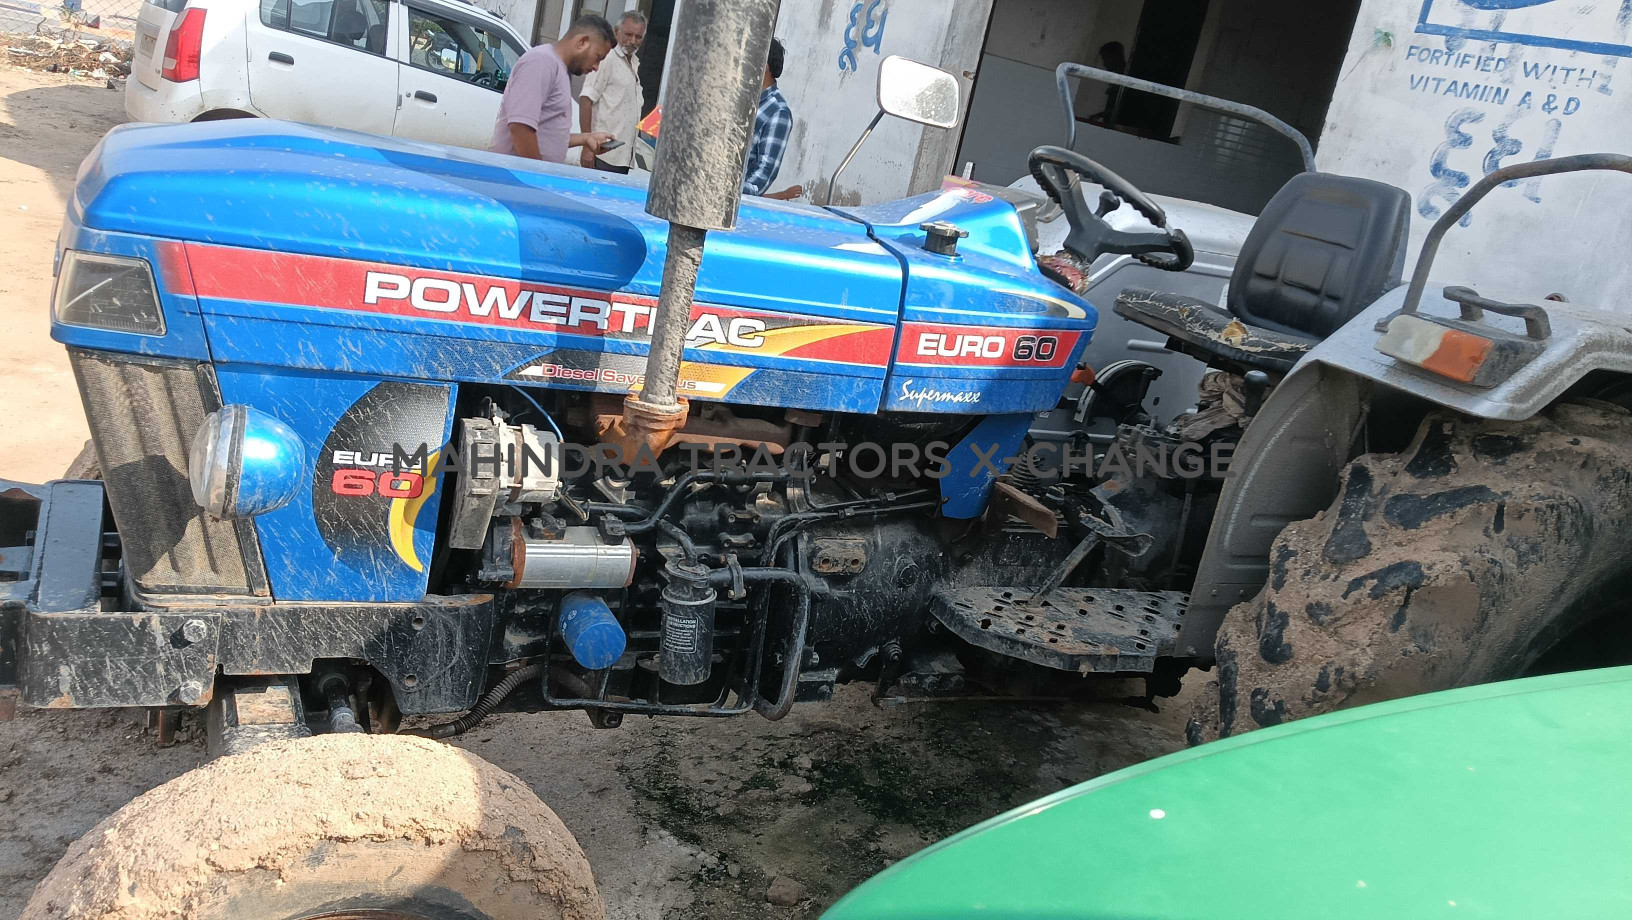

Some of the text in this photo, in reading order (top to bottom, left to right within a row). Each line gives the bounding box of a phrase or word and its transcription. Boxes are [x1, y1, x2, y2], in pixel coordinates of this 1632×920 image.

[1406, 45, 1598, 89] FORTIFIED WITH
[1517, 91, 1532, 110] A
[1541, 94, 1558, 114] &
[1562, 96, 1581, 115] D
[363, 270, 767, 349] POWERTAC
[916, 332, 1059, 362] EURO 60
[541, 363, 599, 381] Diesel
[899, 379, 980, 408] Supermaxx
[331, 467, 425, 500] 60
